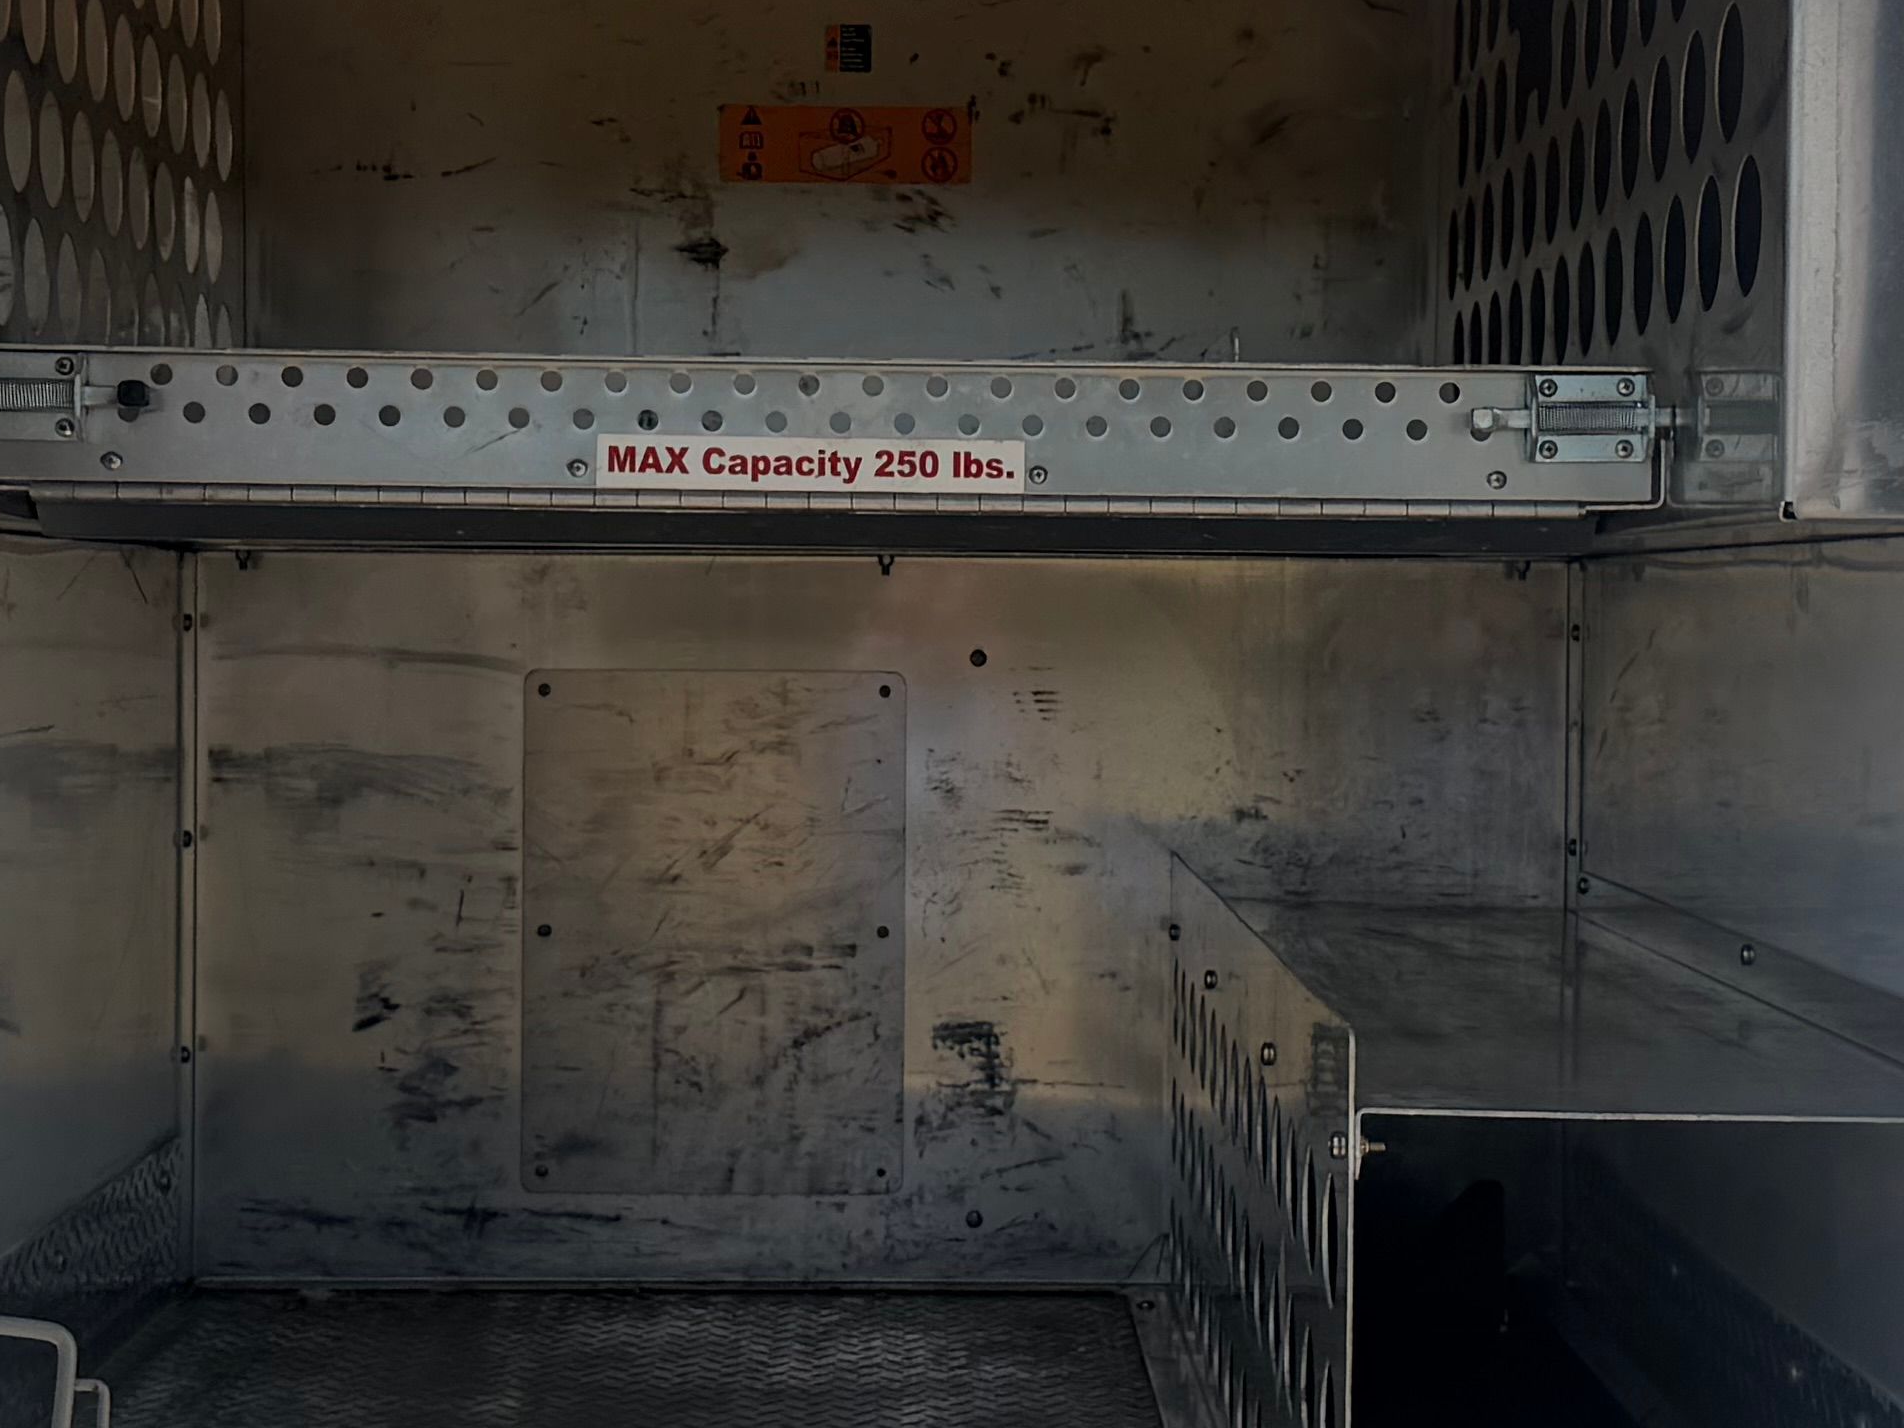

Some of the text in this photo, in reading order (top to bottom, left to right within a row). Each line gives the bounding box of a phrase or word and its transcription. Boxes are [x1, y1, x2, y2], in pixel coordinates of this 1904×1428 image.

[607, 445, 1016, 484] MAX Capacity 250 lbs.
